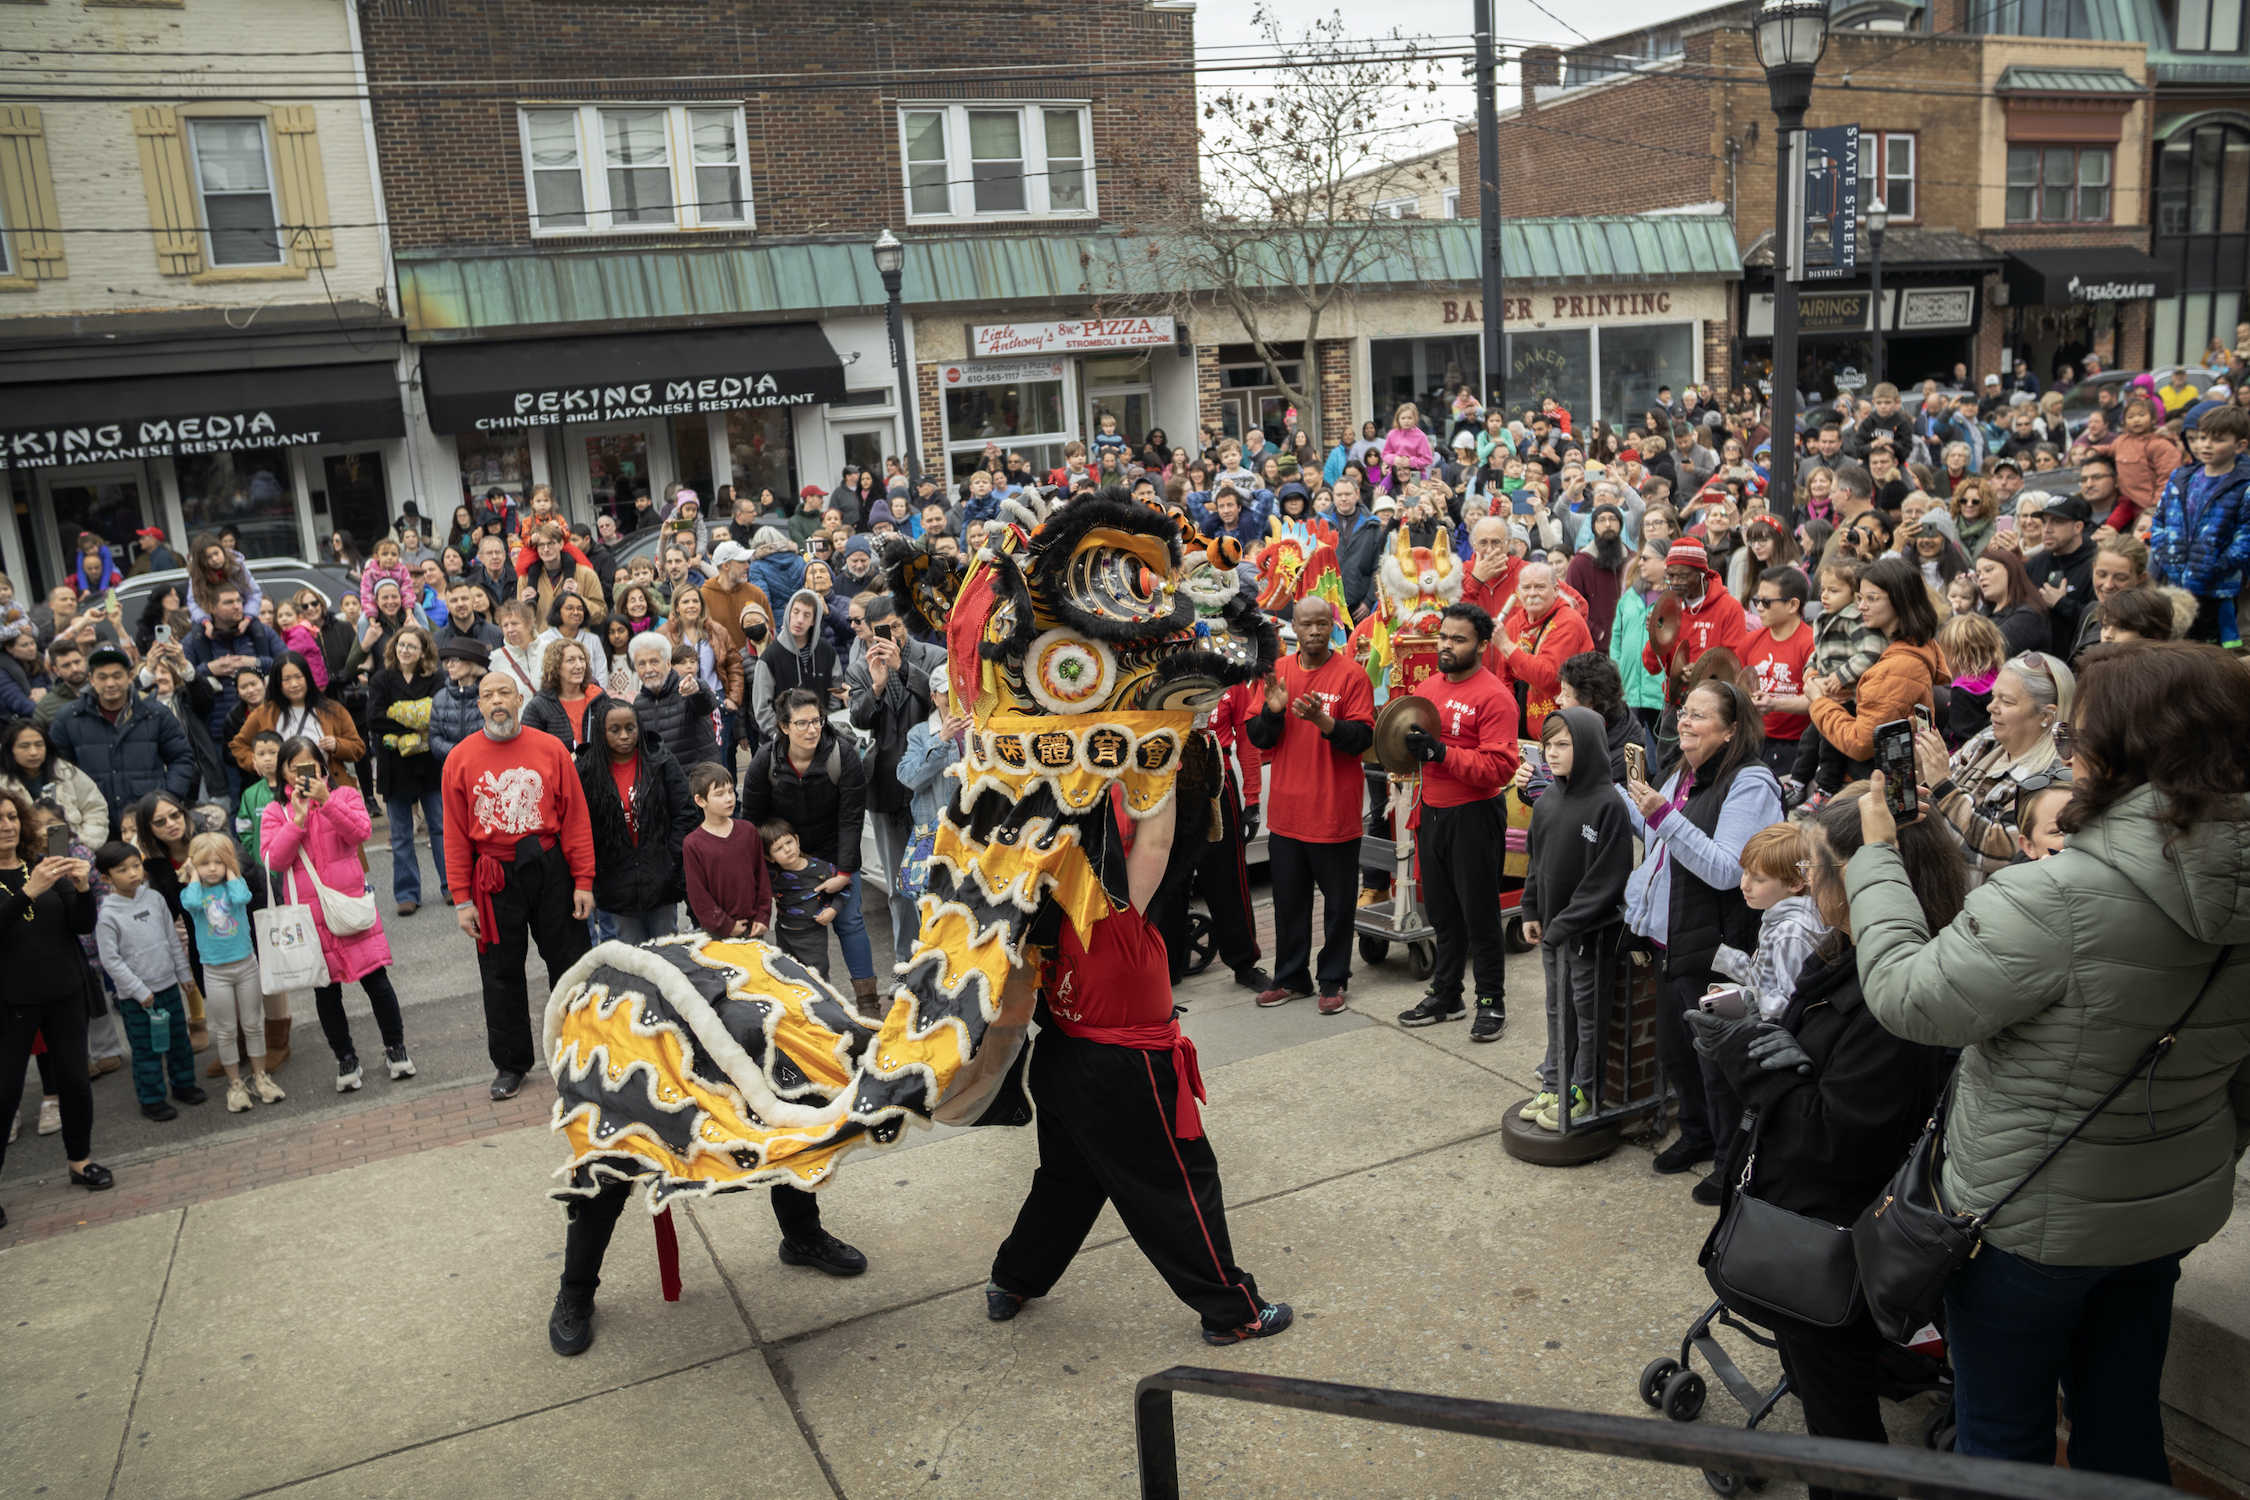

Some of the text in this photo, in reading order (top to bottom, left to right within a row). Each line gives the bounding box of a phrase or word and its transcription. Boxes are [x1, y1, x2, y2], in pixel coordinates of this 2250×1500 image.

[1843, 126, 1858, 266] STATE STREET
[1808, 268, 1843, 279] DISTRICT
[1442, 291, 1672, 324] BAER PRINTING
[979, 324, 1016, 344] Little
[988, 327, 1055, 354] Anthony's
[1066, 334, 1171, 348] STROMBOLI & CALZONE
[1082, 318, 1154, 338] PIZZA
[962, 361, 1051, 374] Little Anthony's Pizza
[1513, 347, 1566, 373] BAKER
[967, 371, 1020, 383] 610-565-1117
[514, 372, 778, 415] PEKING MEDIA
[475, 392, 815, 430] CHINESE and JAPANESE RESTAURANT
[139, 410, 276, 444] MEDIA
[16, 452, 58, 469] and
[65, 443, 173, 467] JAPANESE
[180, 431, 321, 455] RESTAURANT
